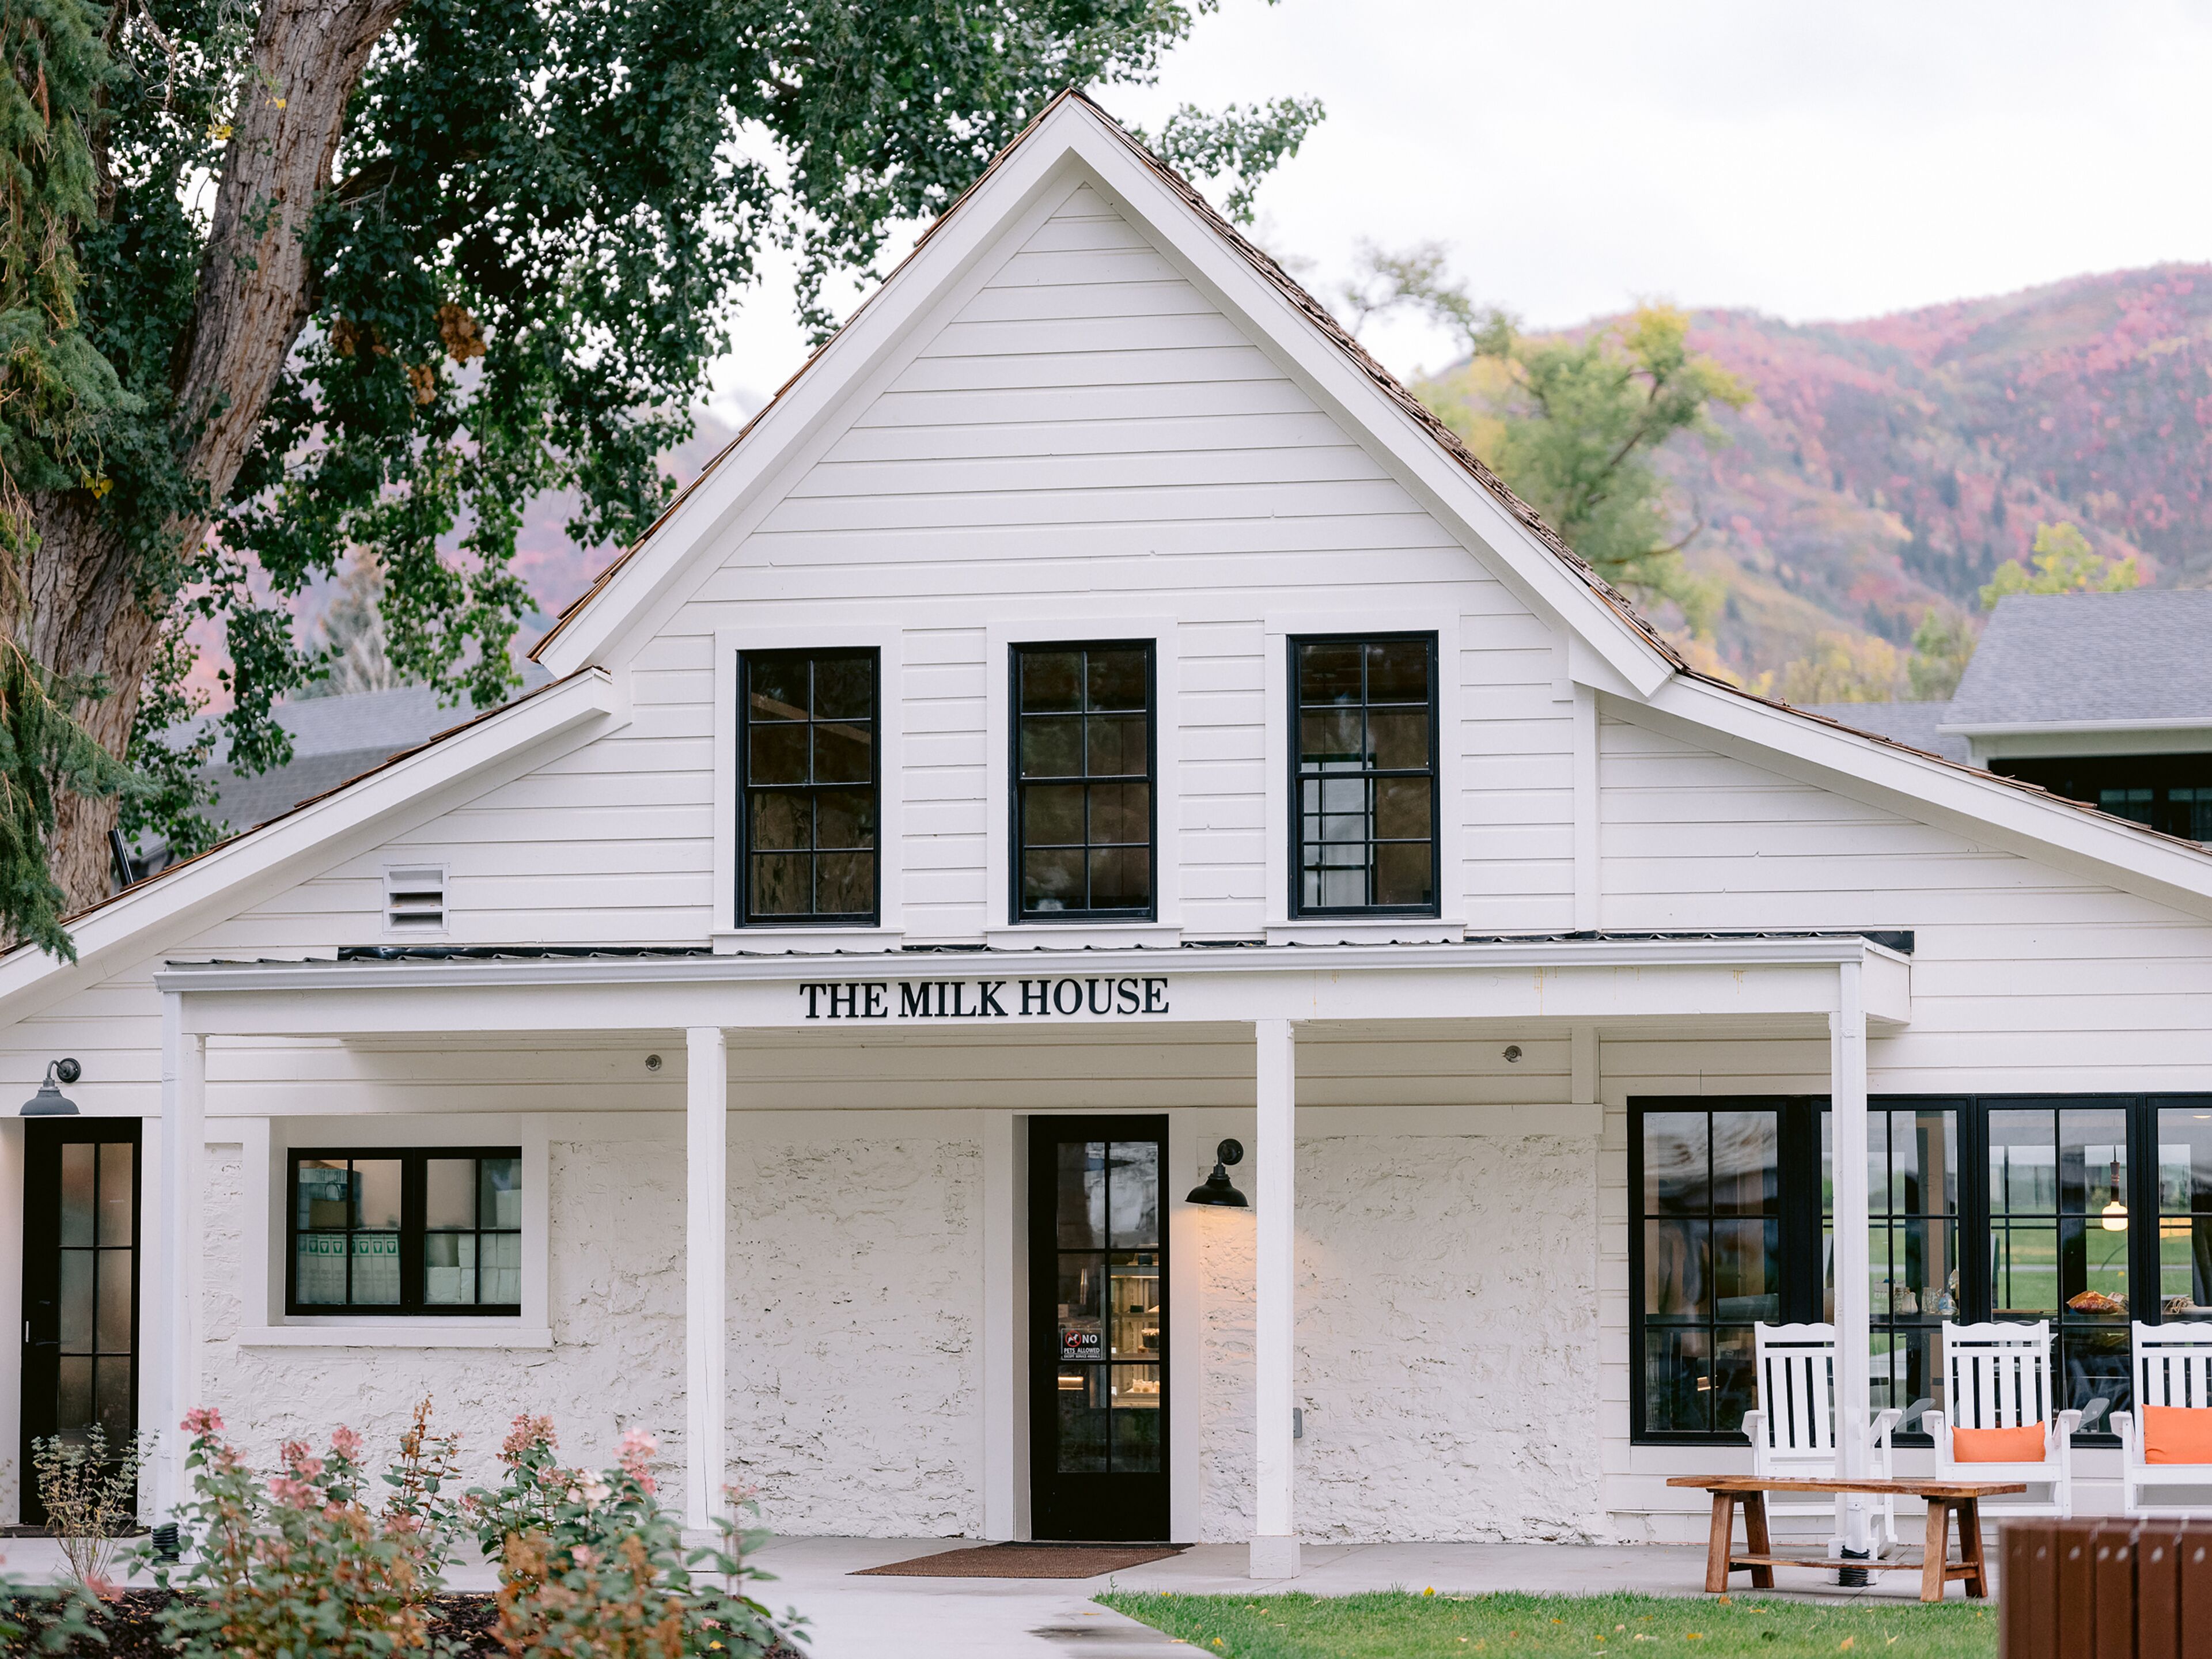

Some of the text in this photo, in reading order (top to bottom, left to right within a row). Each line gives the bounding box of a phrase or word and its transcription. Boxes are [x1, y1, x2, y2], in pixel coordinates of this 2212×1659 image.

[799, 978, 1169, 1018] THE MILK HOUSE
[1082, 1335, 1097, 1343] NO
